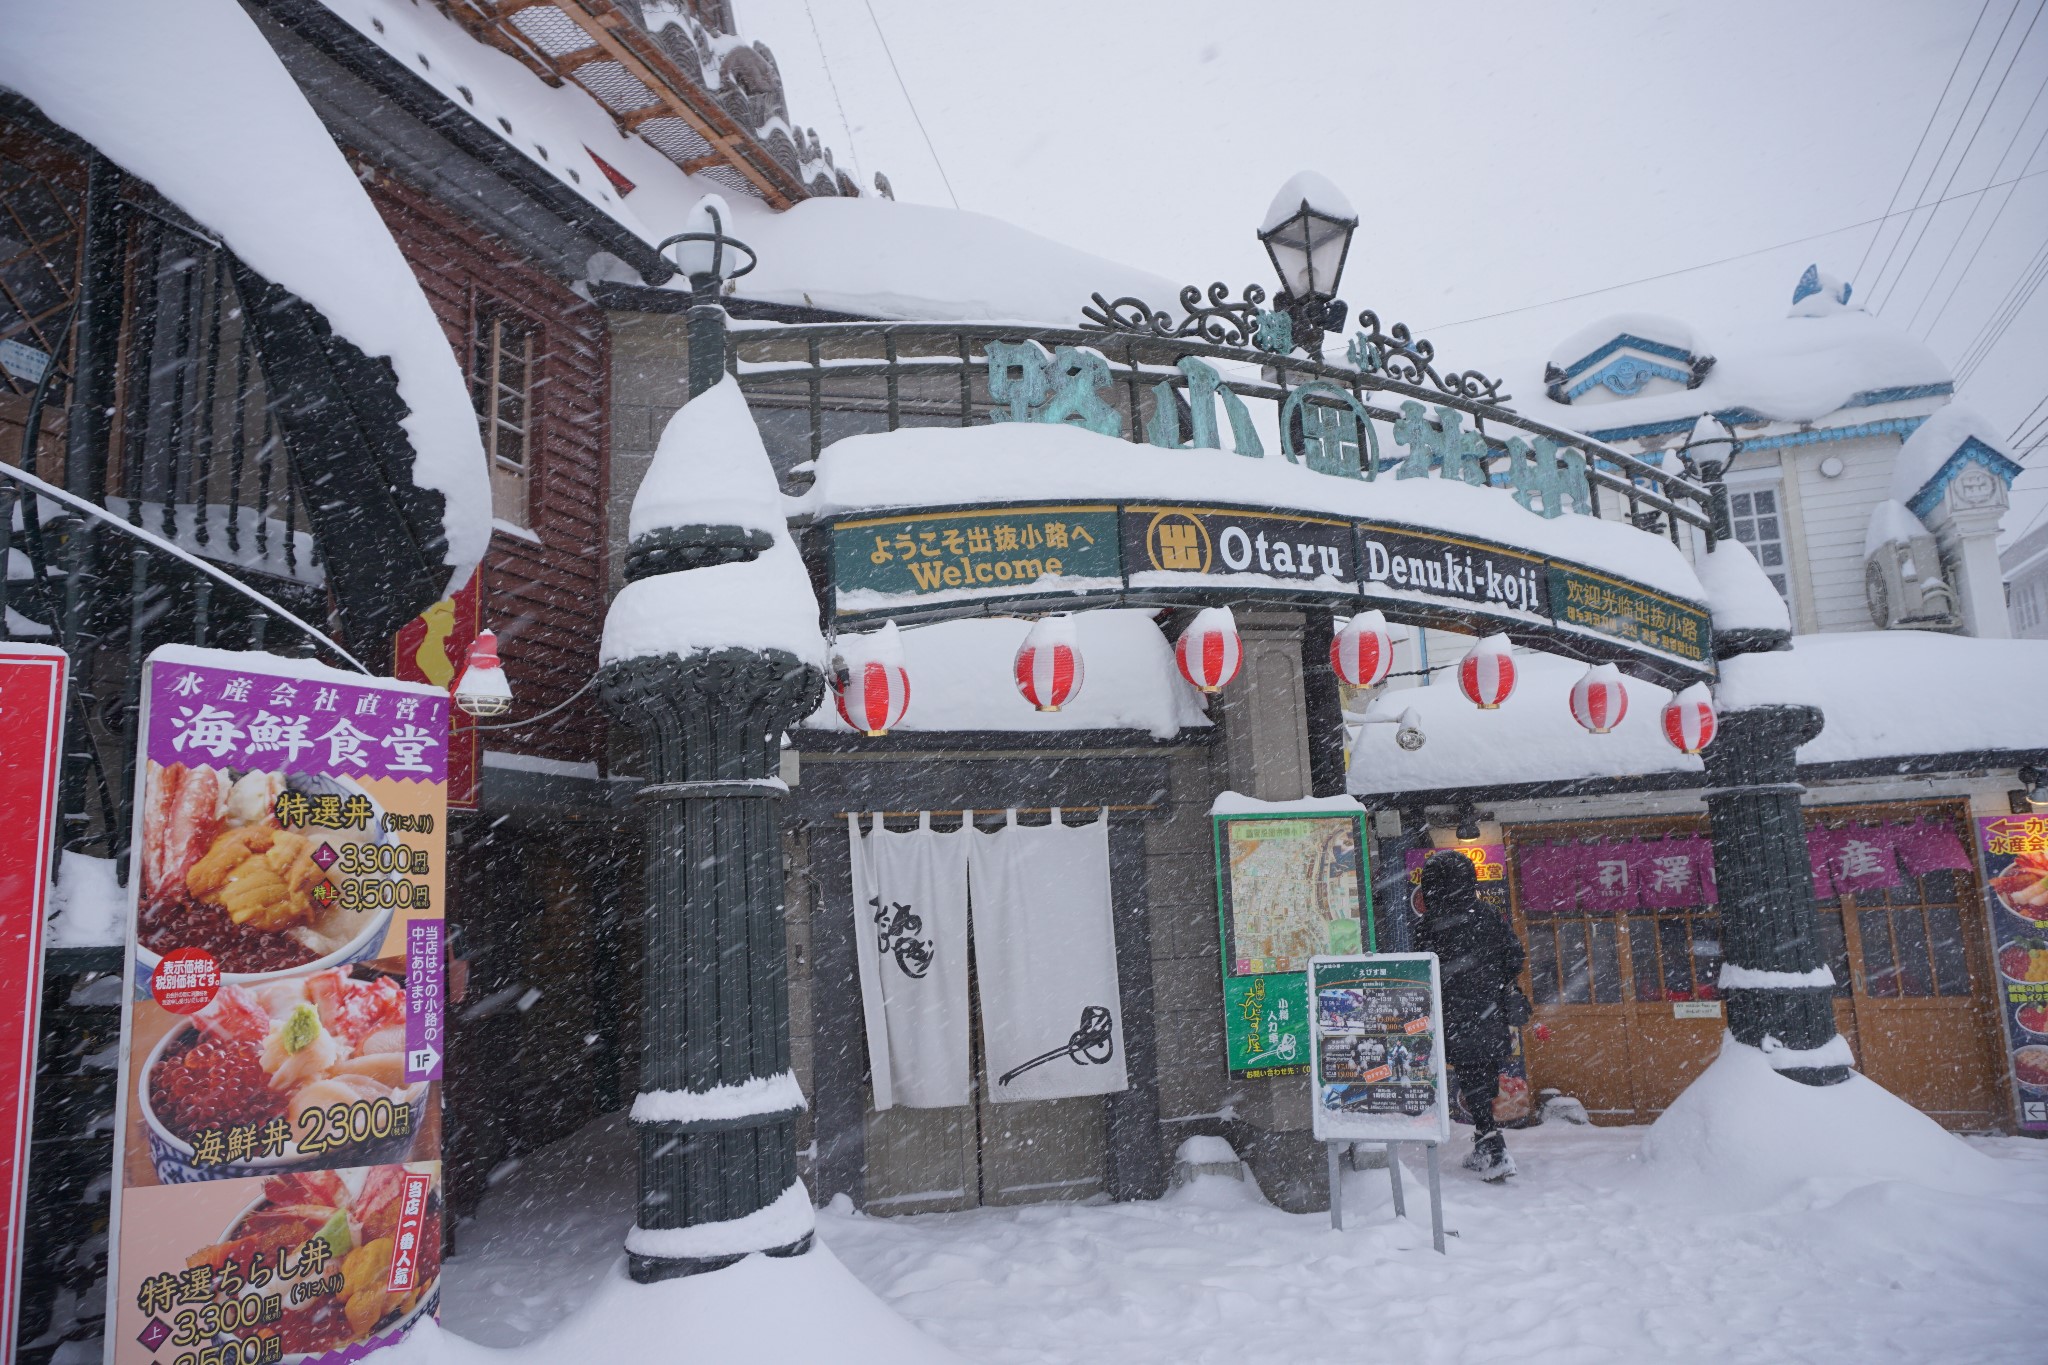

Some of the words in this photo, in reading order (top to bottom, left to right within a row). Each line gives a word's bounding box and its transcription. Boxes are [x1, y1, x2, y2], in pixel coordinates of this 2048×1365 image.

[870, 522, 1094, 565] ようこそ出抜小路へ
[907, 554, 1063, 590] Welcome
[1219, 526, 1344, 577] Otaru
[1366, 540, 1539, 612] Denuki-koji
[171, 671, 440, 722] 水産会社直営！
[170, 704, 439, 773] 海鮮食堂
[277, 793, 373, 829] 特選丼
[319, 850, 331, 861] 上
[340, 844, 428, 876] 3,300円
[313, 886, 338, 900] 特上
[341, 879, 429, 912] 3,500円
[155, 973, 220, 990] 税別価格です。
[163, 959, 214, 974] 表示価格は
[411, 926, 424, 1014] 中にあります
[424, 926, 438, 1041] 当店はこの小路の
[415, 1054, 430, 1068] 1F
[191, 1119, 291, 1166] 海鮮丼
[298, 1098, 410, 1153] 2,300円
[138, 1238, 332, 1316] 特選ちらし丼
[290, 1273, 345, 1305] (うに入り)
[148, 1326, 163, 1341] 上
